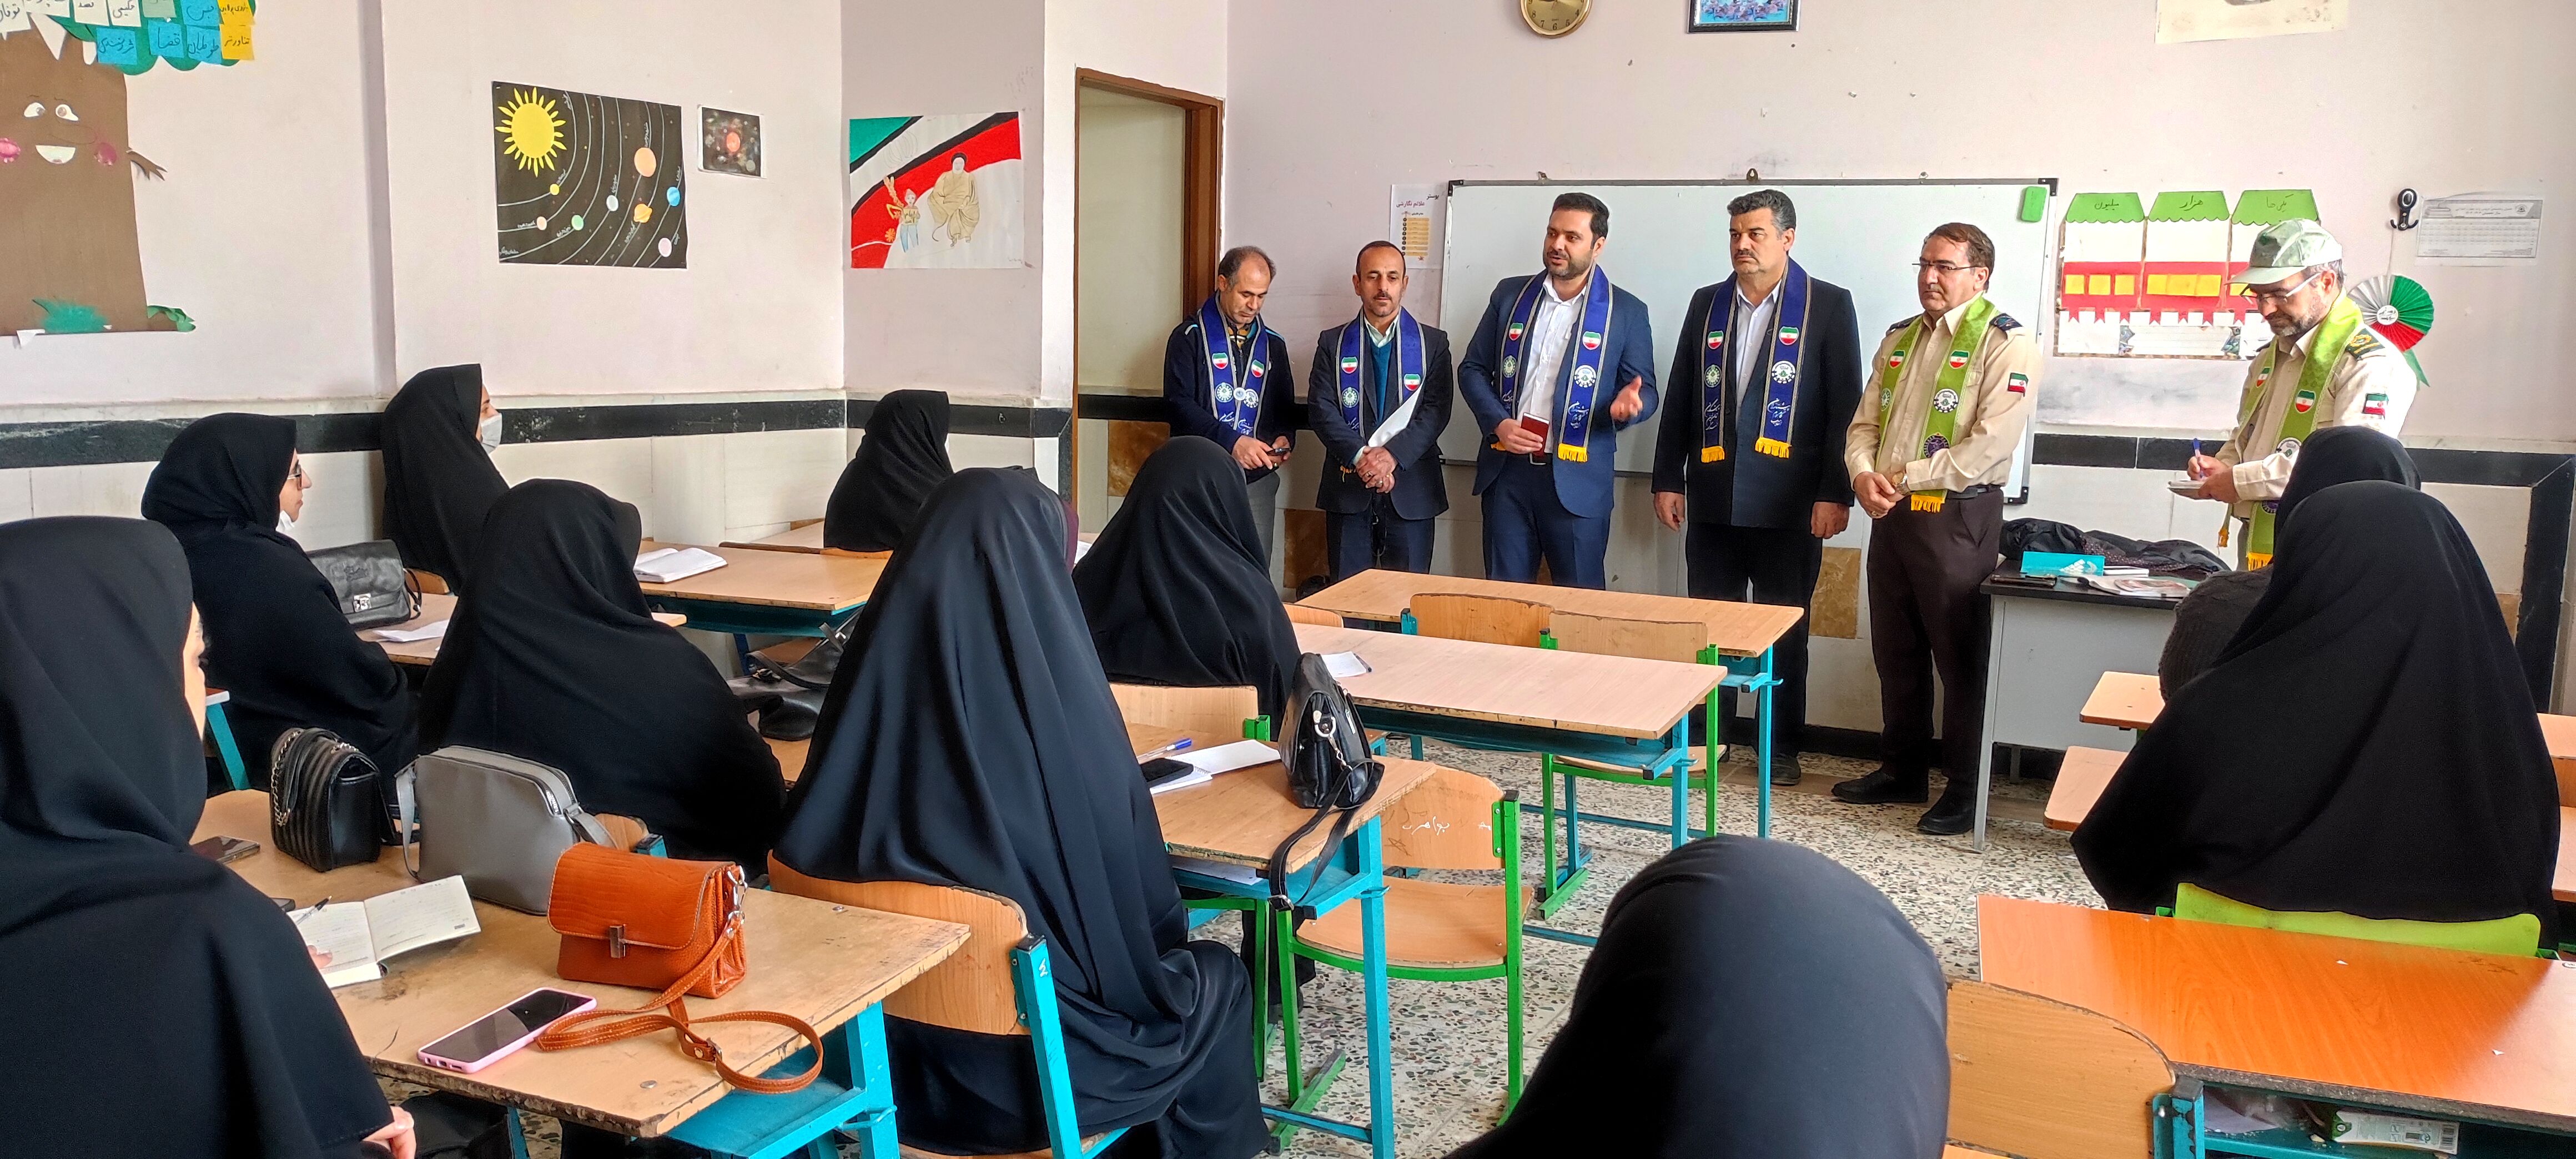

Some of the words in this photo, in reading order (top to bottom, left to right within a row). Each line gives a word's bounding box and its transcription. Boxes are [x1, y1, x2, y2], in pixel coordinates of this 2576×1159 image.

[1531, 10, 1536, 18] 8
[1575, 9, 1579, 17] 4
[2179, 195, 2203, 211] هزار
